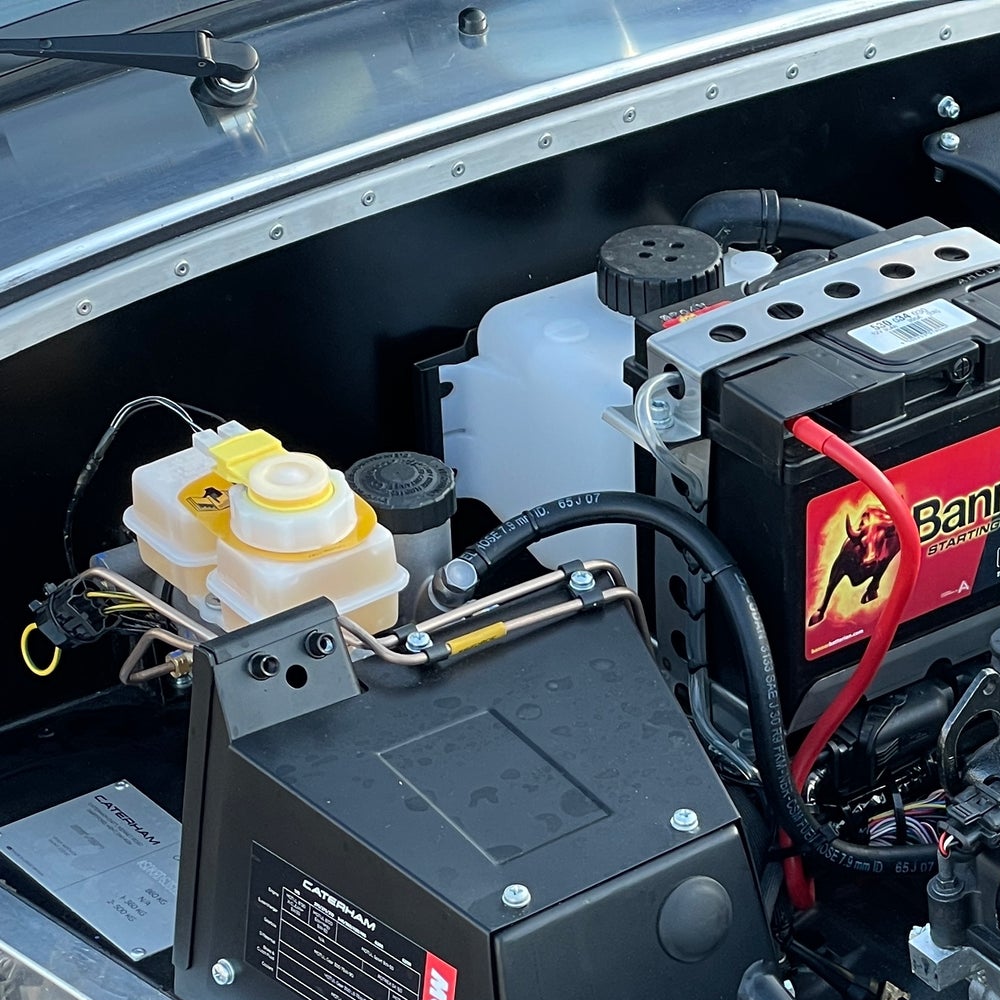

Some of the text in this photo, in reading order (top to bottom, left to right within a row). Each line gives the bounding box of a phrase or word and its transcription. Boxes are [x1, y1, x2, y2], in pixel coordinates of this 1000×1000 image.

[585, 492, 601, 505] 07
[765, 674, 779, 701] SAE
[853, 860, 871, 872] mm
[872, 861, 884, 873] ID
[920, 861, 935, 872] 07
[94, 794, 162, 847] CATERHAM
[302, 879, 377, 932] CATERHAM
